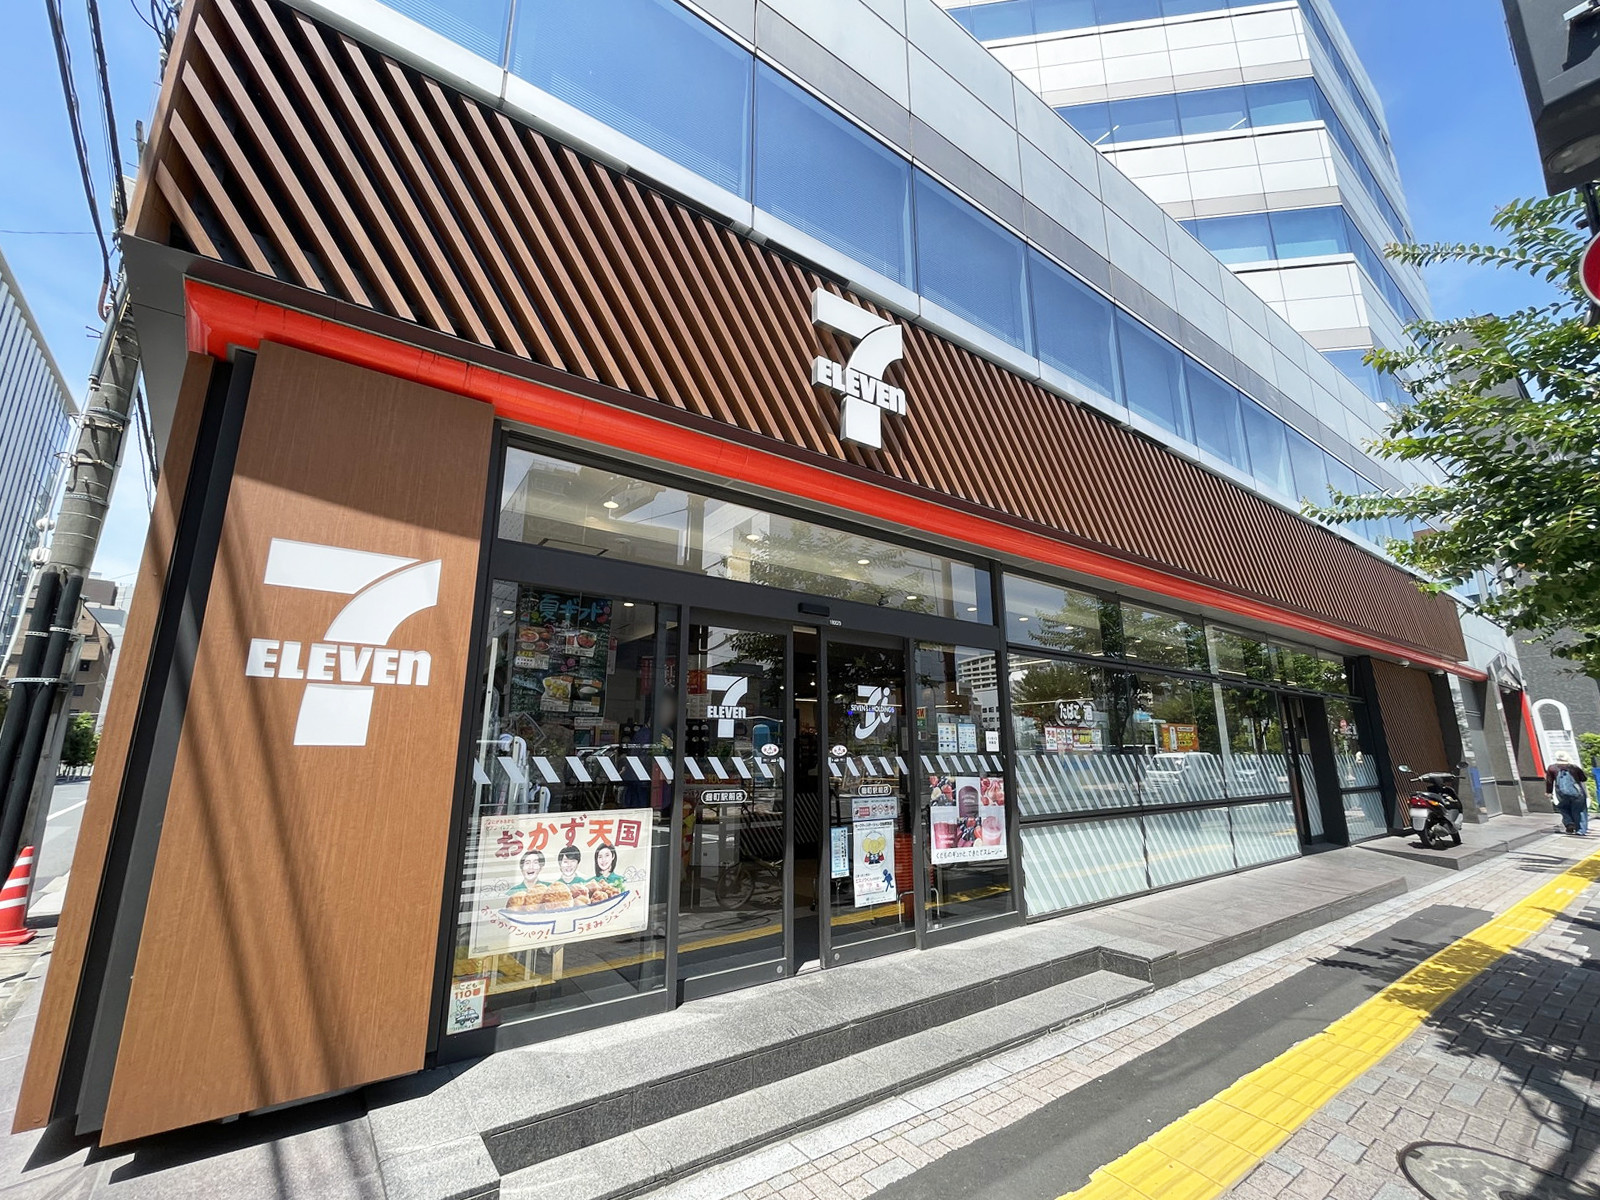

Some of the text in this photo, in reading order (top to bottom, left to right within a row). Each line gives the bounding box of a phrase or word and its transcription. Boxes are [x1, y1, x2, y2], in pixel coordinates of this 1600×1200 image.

[812, 288, 903, 448] 7
[539, 594, 603, 622] 夏ギフト
[264, 537, 442, 746] 7
[707, 674, 748, 738] 7
[1059, 703, 1081, 719] たばこ
[495, 814, 642, 859] おかず天国
